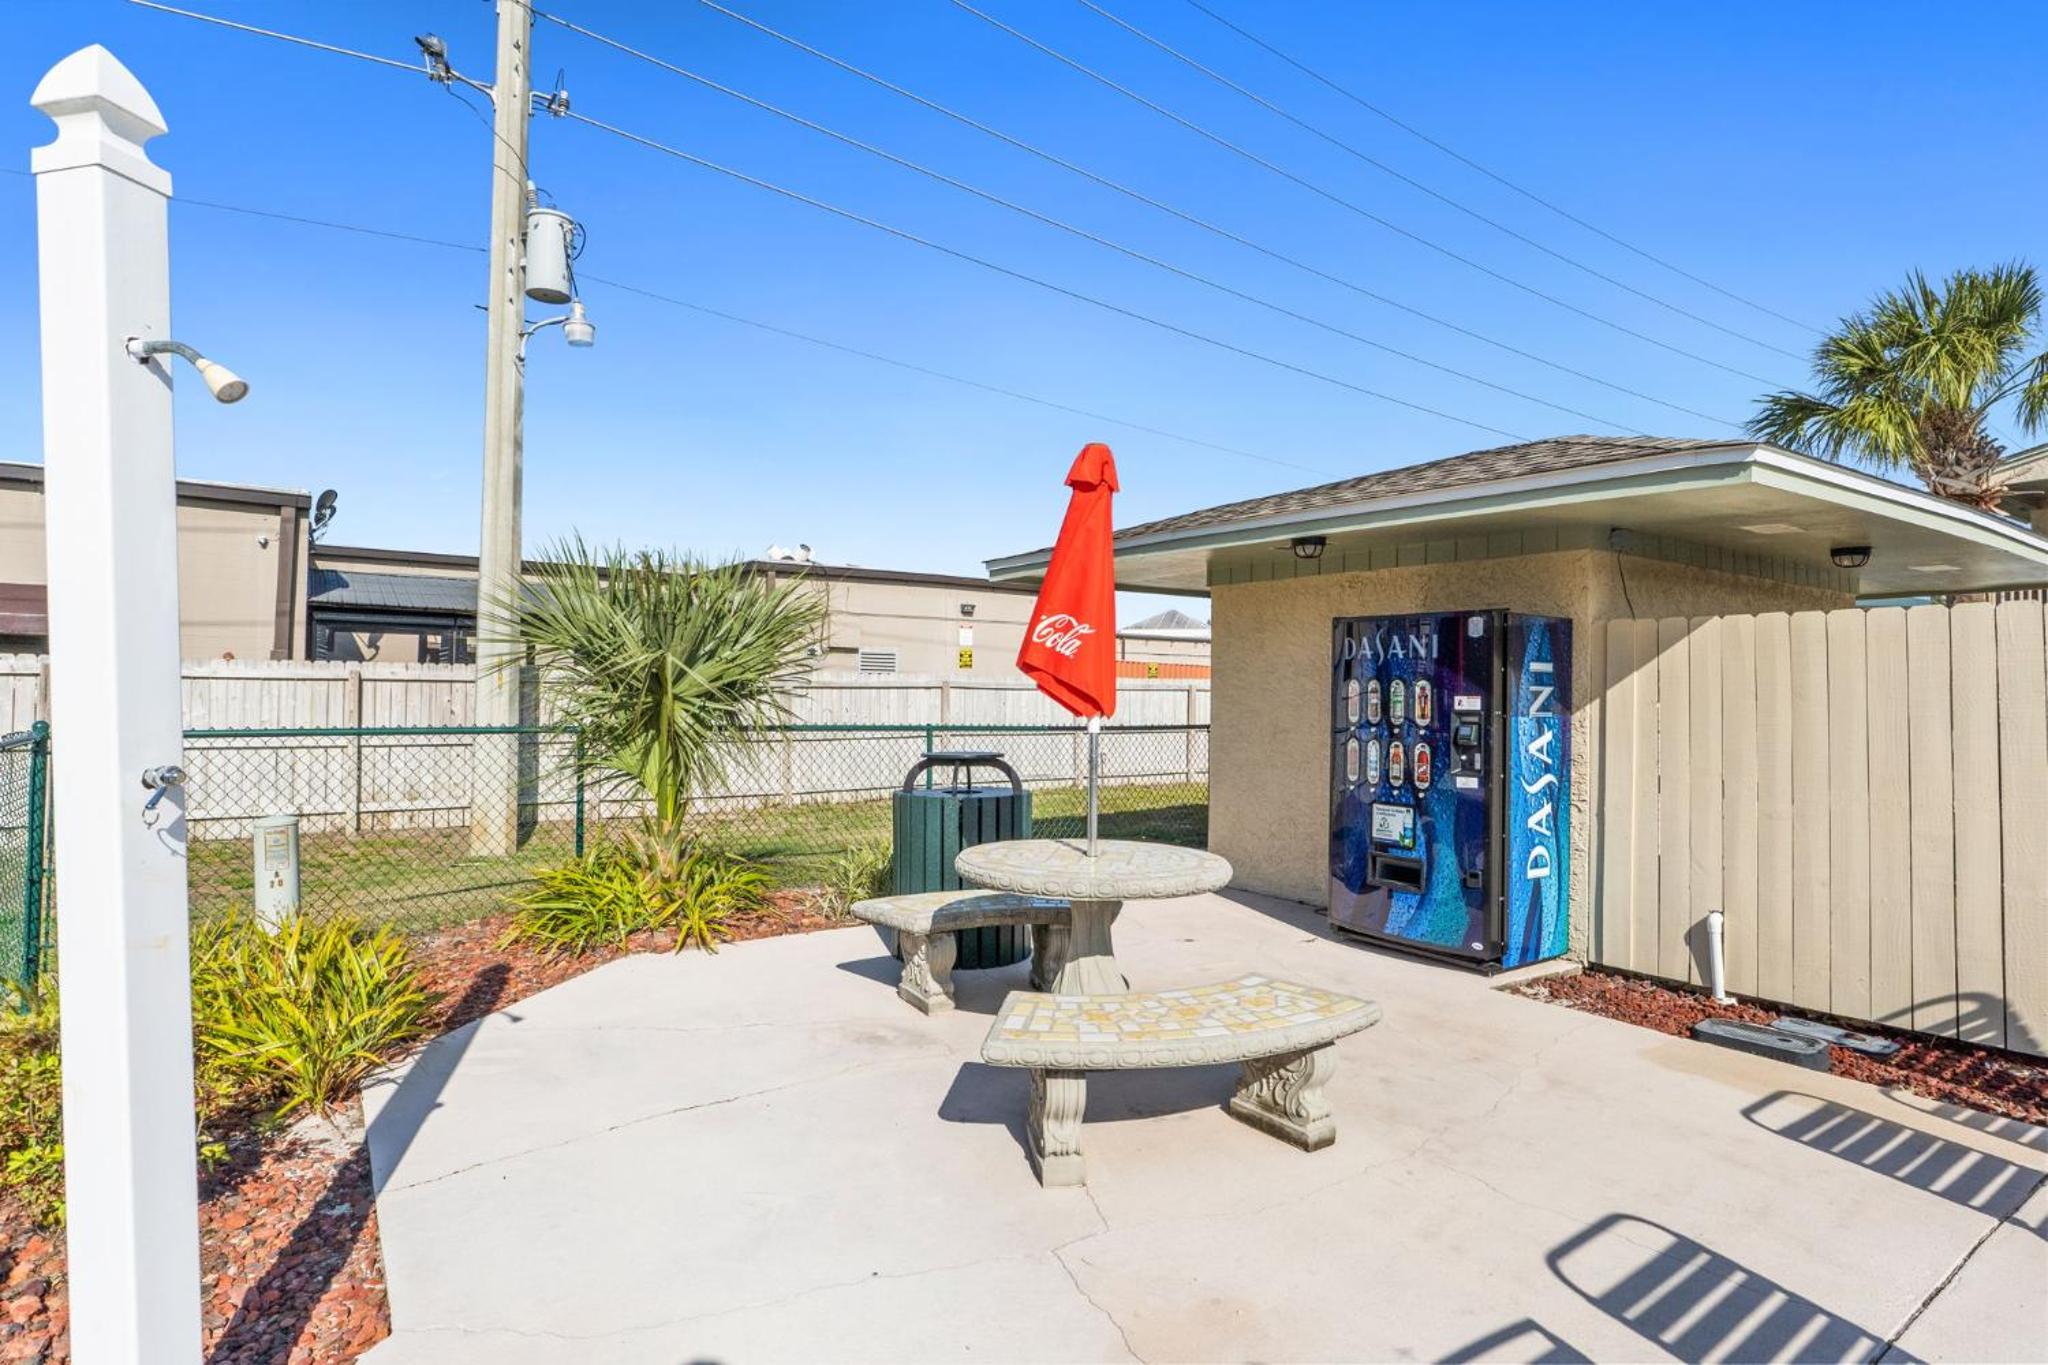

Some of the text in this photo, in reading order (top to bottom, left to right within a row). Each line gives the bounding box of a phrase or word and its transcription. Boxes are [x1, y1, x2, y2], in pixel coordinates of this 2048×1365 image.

[1032, 614, 1096, 658] Cola
[1344, 628, 1438, 666] DASANI
[1521, 661, 1558, 880] DASANI
